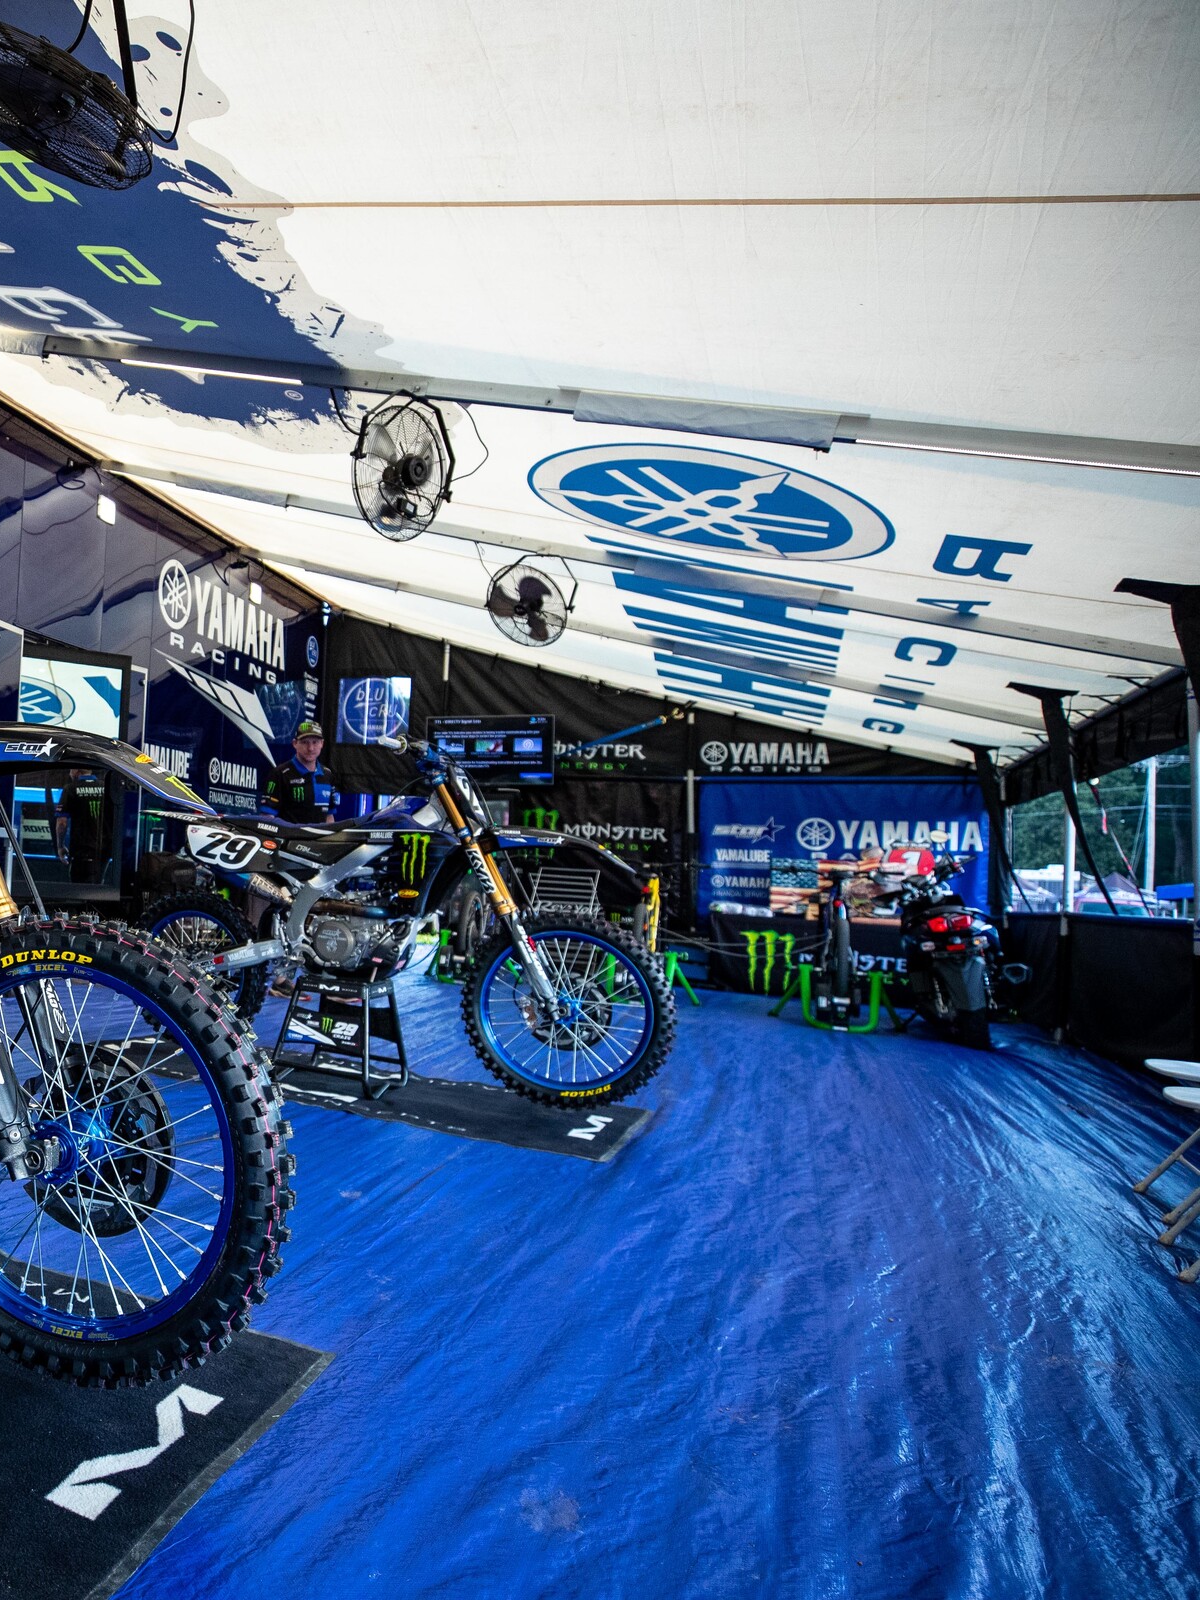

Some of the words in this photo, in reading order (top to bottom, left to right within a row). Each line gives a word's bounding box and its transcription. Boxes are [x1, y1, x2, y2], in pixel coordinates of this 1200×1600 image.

[194, 574, 286, 672] YAMAHA
[169, 631, 277, 685] RACING
[553, 740, 647, 761] ONSTER
[729, 742, 830, 766] YAMAHA
[144, 743, 190, 779] AMALUBE
[709, 765, 823, 773] RACING
[220, 760, 258, 790] YAMAHA
[209, 790, 235, 807] FINANCIAL
[235, 795, 257, 809] SERVICES
[158, 811, 198, 822] DUNLOP
[257, 822, 279, 834] YAMAHA
[563, 823, 668, 842] MONSTER
[837, 820, 985, 852] YAMAHA
[196, 832, 256, 867] 29
[714, 848, 771, 863] YAMALUBE
[0, 949, 93, 969] DUNLOP
[35, 964, 68, 972] EXCEL
[332, 1021, 359, 1036] 29
[560, 1084, 612, 1098] DUNLOP
